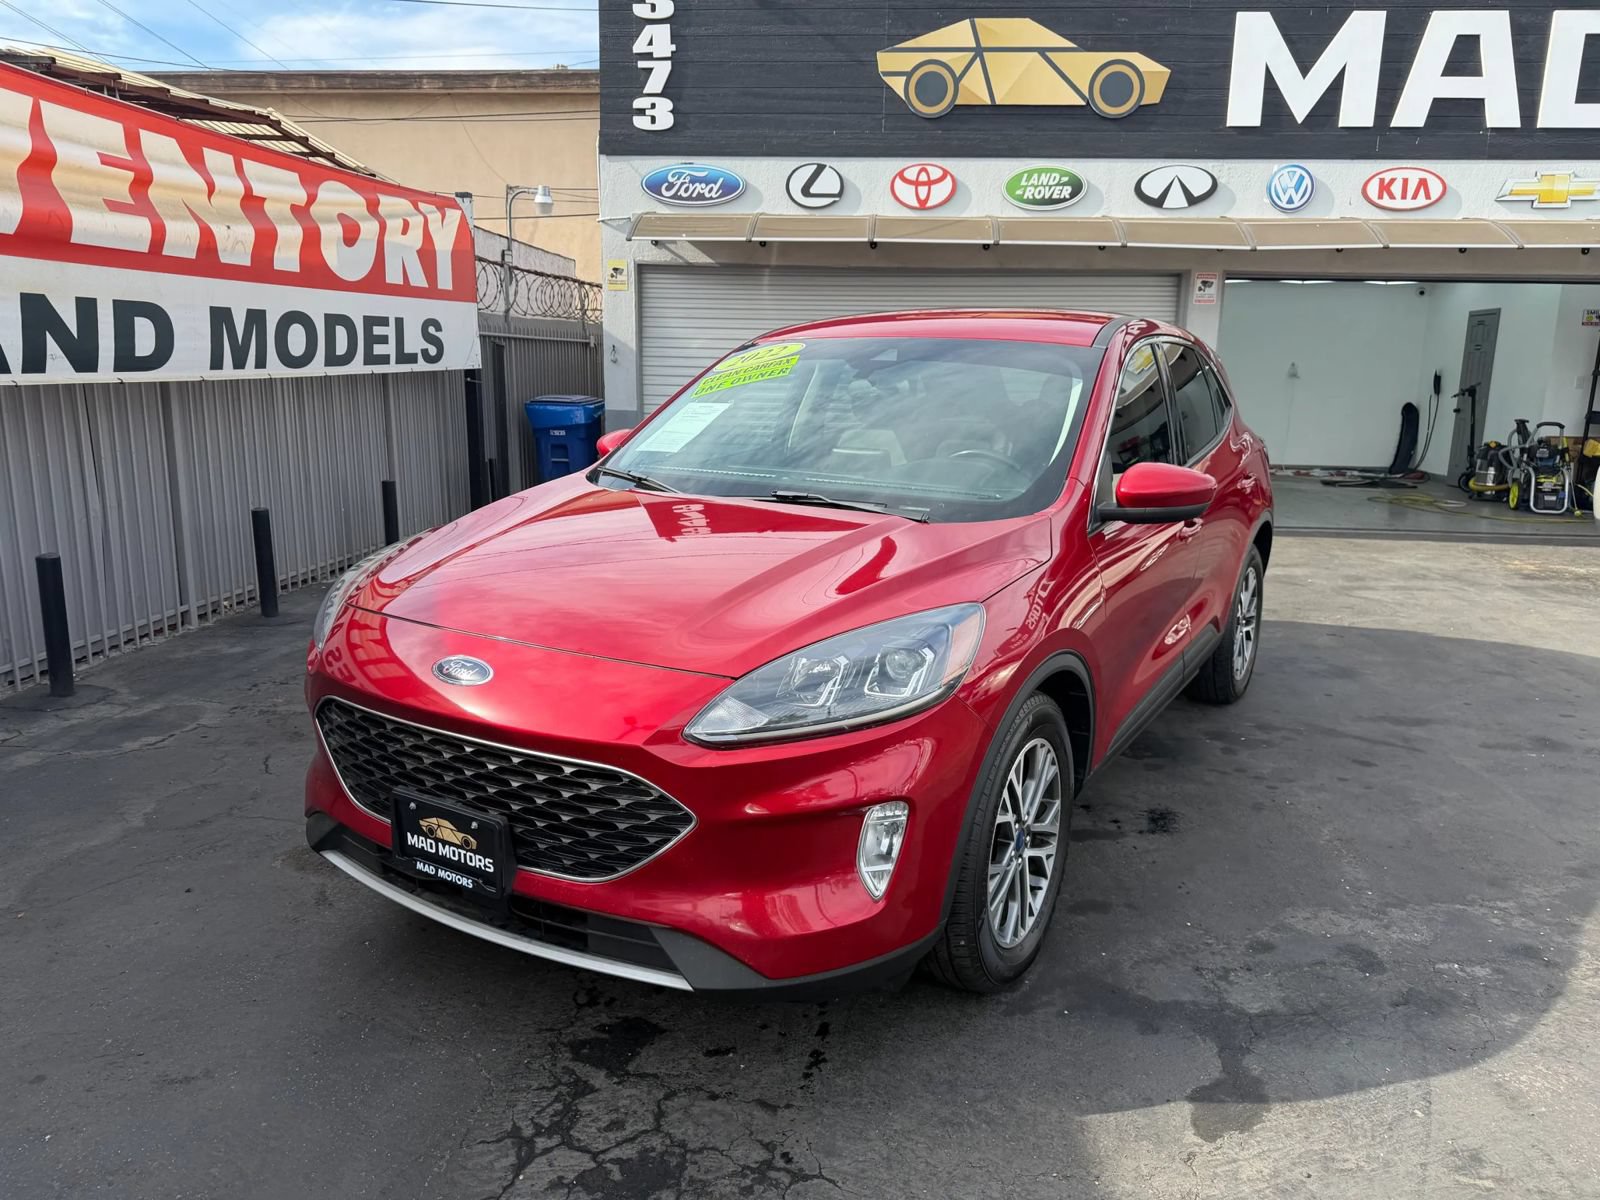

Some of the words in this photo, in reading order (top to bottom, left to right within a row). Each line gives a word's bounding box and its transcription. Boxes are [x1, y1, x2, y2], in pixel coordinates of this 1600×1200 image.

[0, 88, 462, 291] ENTORY
[661, 168, 723, 198] Ford
[1020, 172, 1060, 186] LAND
[1023, 185, 1072, 199] ROVER
[1377, 177, 1431, 201] KIA
[0, 292, 175, 375] ND
[208, 305, 445, 371] MODELS
[694, 381, 729, 396] ONE
[730, 367, 789, 385] OWNER
[702, 368, 741, 385] CLEAN
[743, 358, 792, 373] CARFAX
[442, 659, 479, 679] Ford
[406, 831, 436, 854] MAD
[438, 842, 495, 873] MOTORS
[416, 861, 436, 875] MAD
[437, 868, 473, 889] MOTORS
